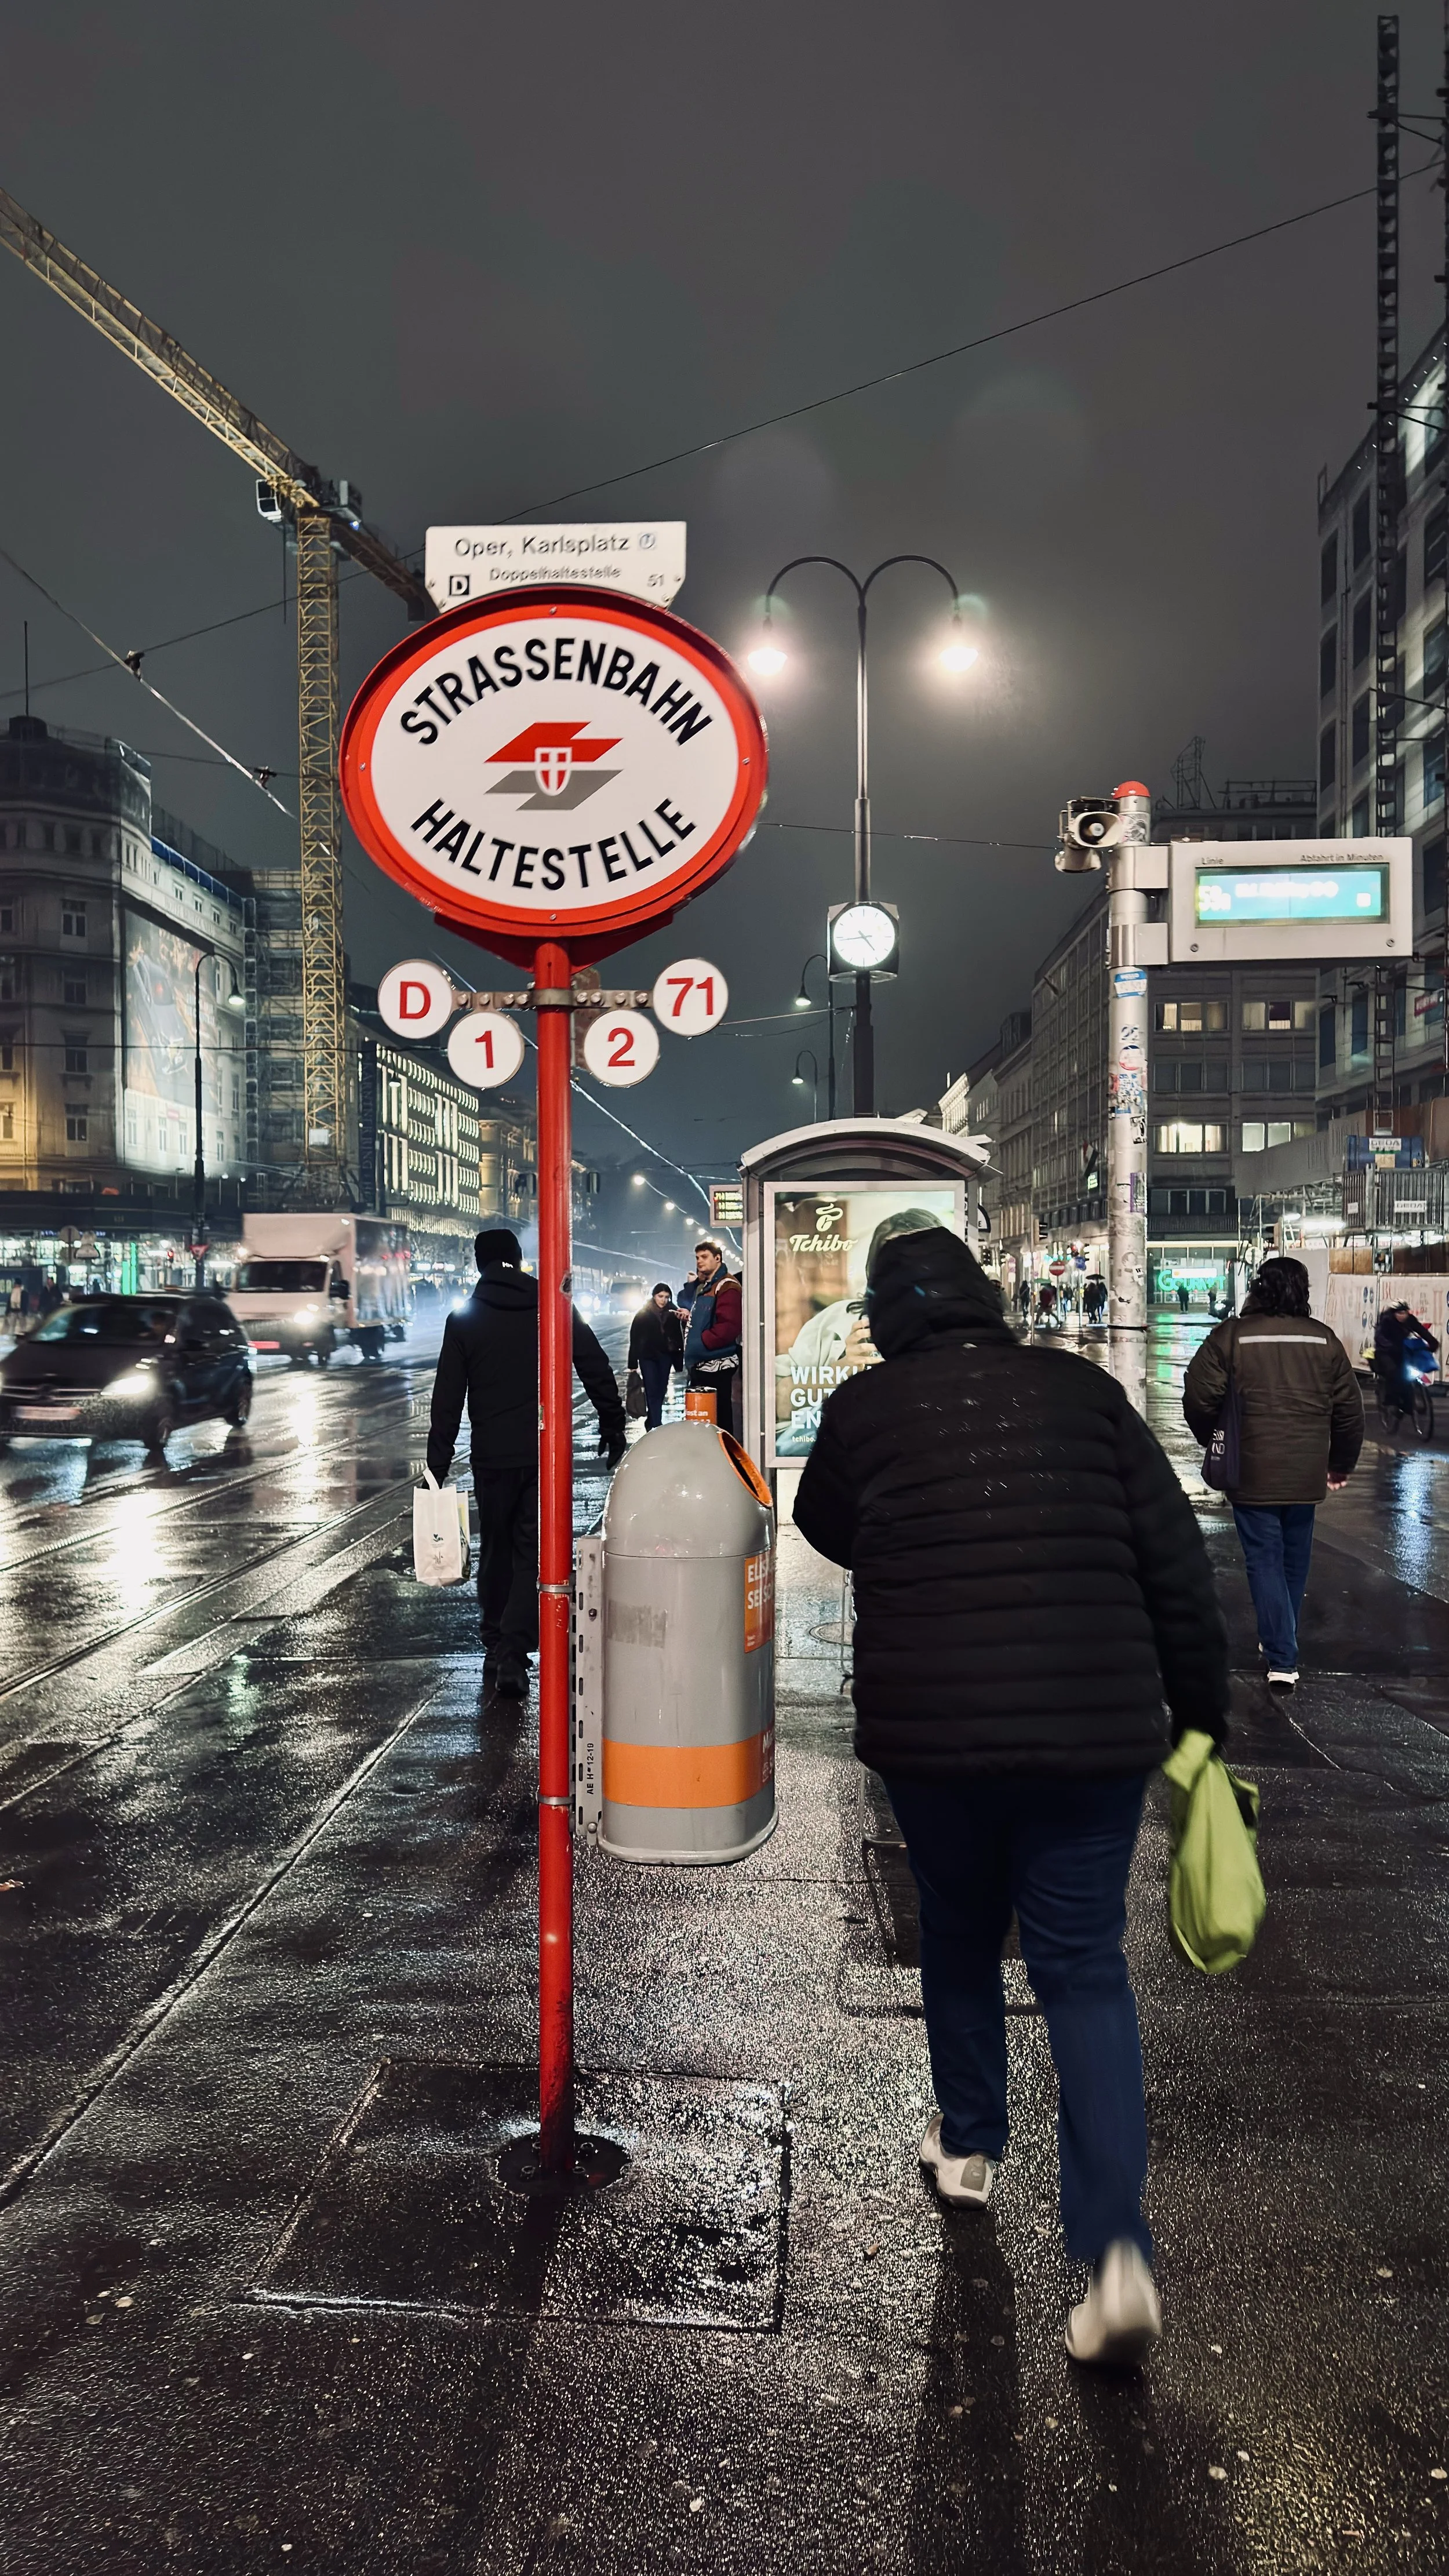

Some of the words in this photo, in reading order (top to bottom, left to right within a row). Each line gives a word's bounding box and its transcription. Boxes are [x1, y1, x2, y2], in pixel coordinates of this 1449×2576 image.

[454, 537, 514, 559] Oper,
[523, 533, 629, 558] Karlsplatz
[453, 576, 469, 595] D
[490, 564, 622, 582] Doppelhaltestelle
[400, 638, 712, 746] STRASSENBAHN
[410, 798, 697, 891] HALTESTELLE
[399, 981, 431, 1020] D
[667, 976, 714, 1017] 71
[475, 1030, 494, 1069] 1
[607, 1027, 635, 1067] 2
[789, 1235, 858, 1252] Tchibo
[791, 1366, 872, 1385] WIRK
[587, 1784, 594, 1795] AE
